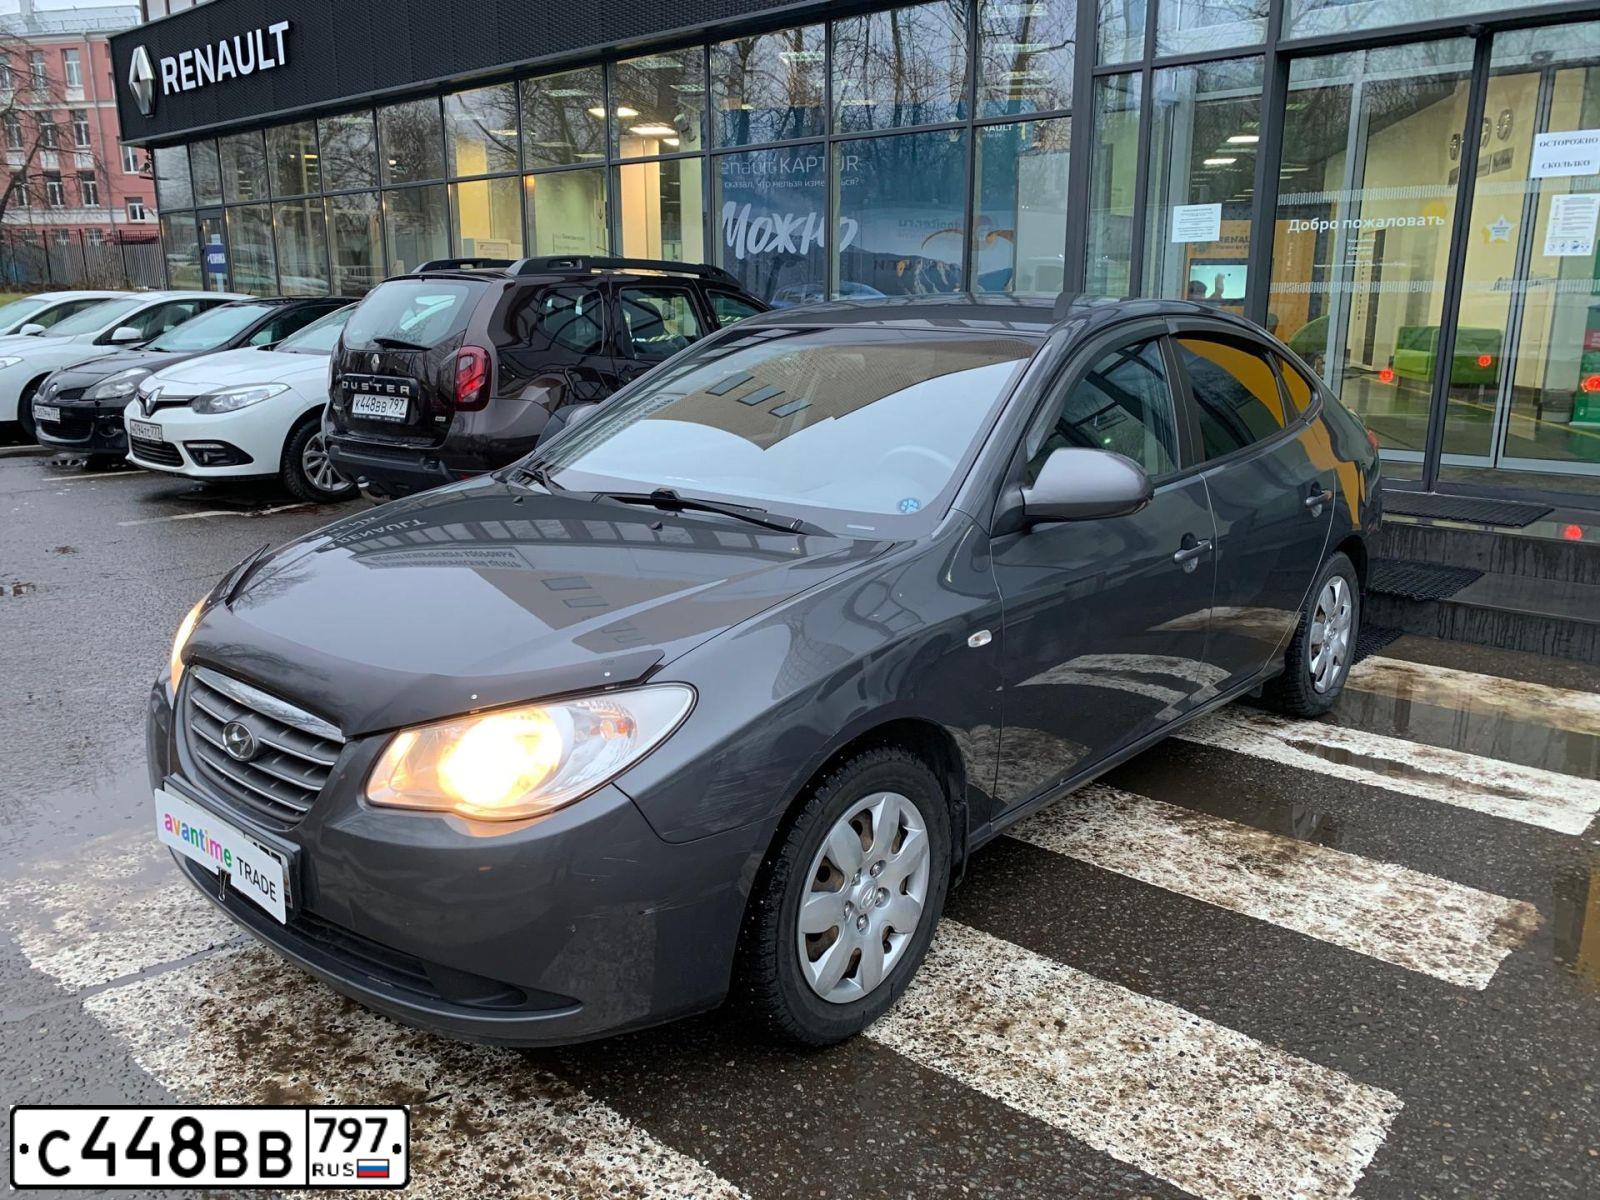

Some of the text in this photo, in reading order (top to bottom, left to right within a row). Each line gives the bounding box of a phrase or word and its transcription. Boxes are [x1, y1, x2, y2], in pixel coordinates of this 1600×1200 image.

[160, 20, 290, 95] RENAULT
[721, 158, 777, 175] enault
[1287, 215, 1446, 233] Добро пожаловать
[341, 381, 410, 396] DUSTER
[389, 398, 404, 410] 797
[164, 812, 233, 868] avantime
[236, 856, 277, 902] TRADE
